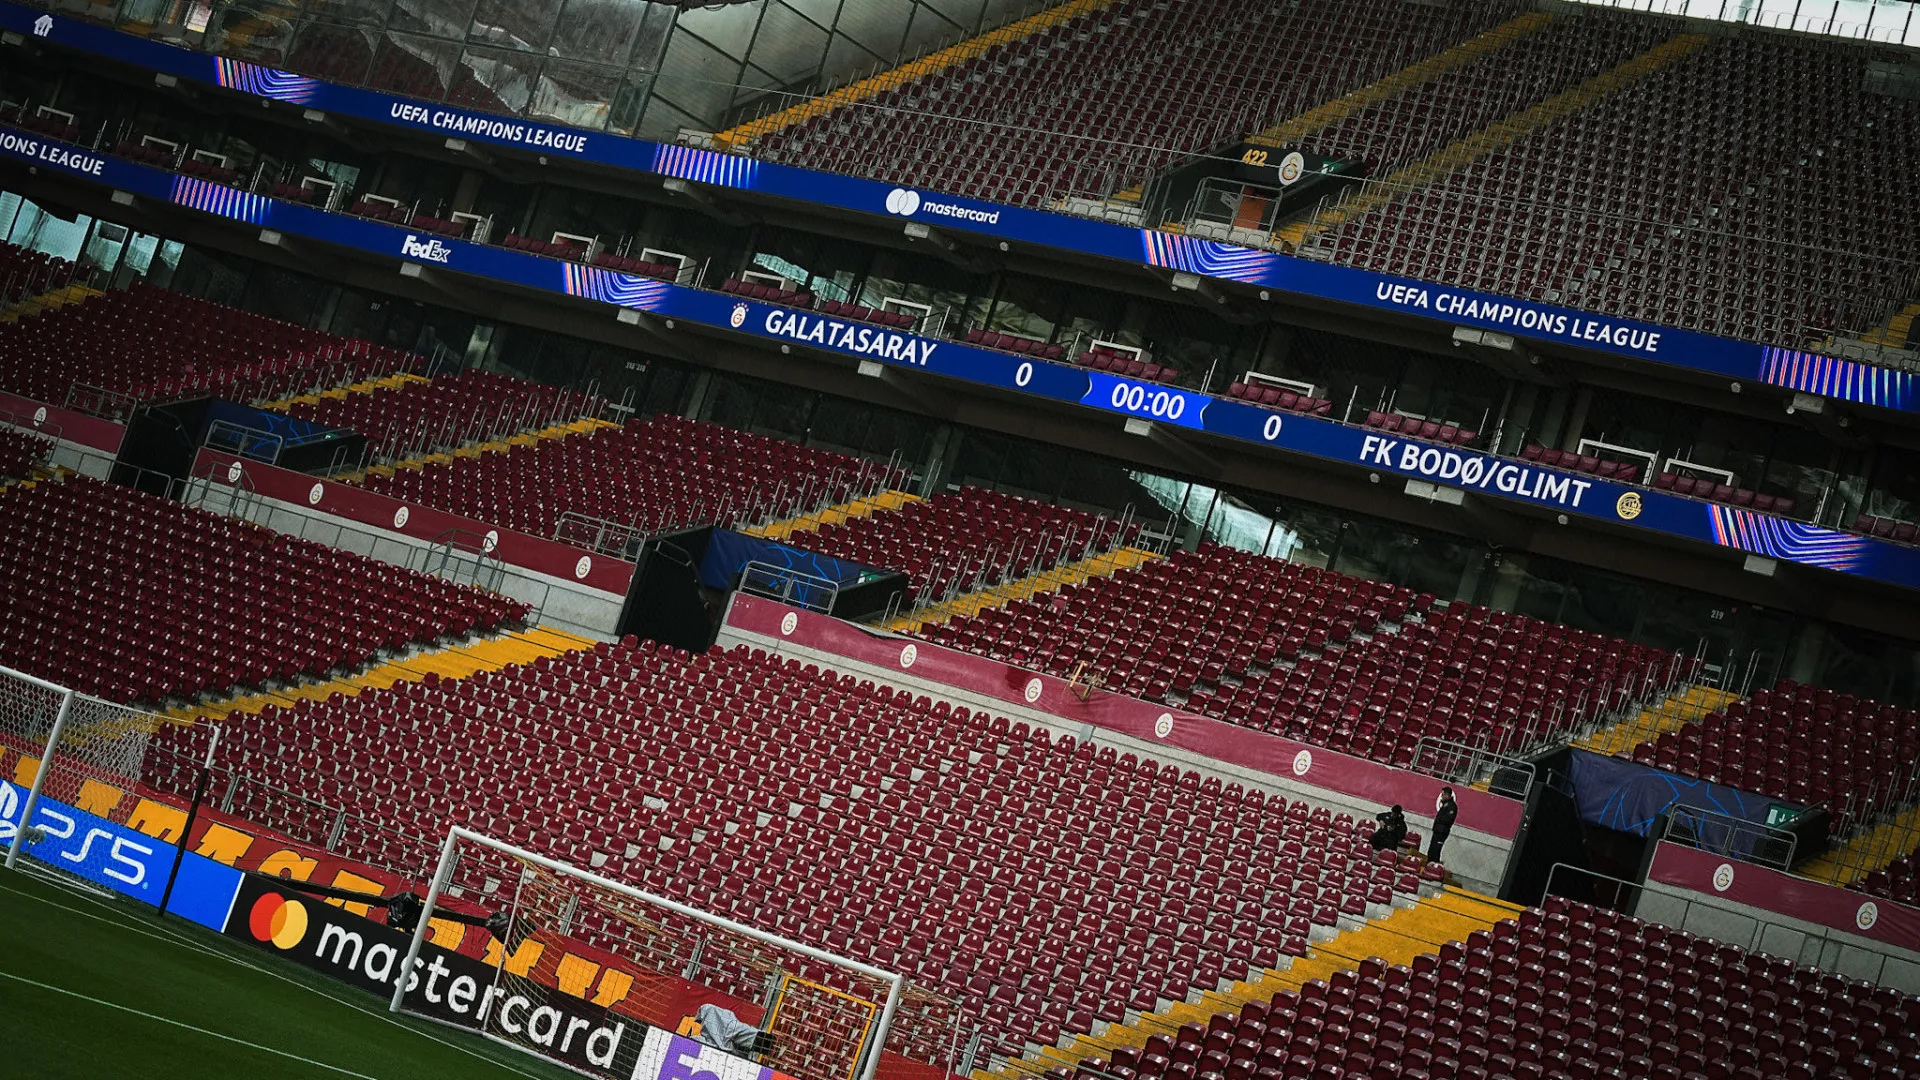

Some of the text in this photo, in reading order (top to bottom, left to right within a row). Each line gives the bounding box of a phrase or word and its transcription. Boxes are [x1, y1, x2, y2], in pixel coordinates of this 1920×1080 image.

[391, 102, 587, 153] UEFA CHAMPIONS LEAGUE
[39, 144, 105, 176] LEAGUE
[1242, 148, 1268, 167] 422
[922, 201, 1000, 224] mastercard
[401, 234, 451, 263] FedEx
[1376, 281, 1661, 352] UEFA CHAMPIONS LEAGUE
[765, 310, 937, 366] GALATASARAY
[1015, 362, 1033, 387] 0
[1111, 382, 1185, 420] 00:00
[1264, 414, 1282, 441] 0
[1359, 435, 1592, 508] FK BODØ/GLIMT
[37, 807, 153, 886] PS5
[314, 922, 625, 1070] mastercard
